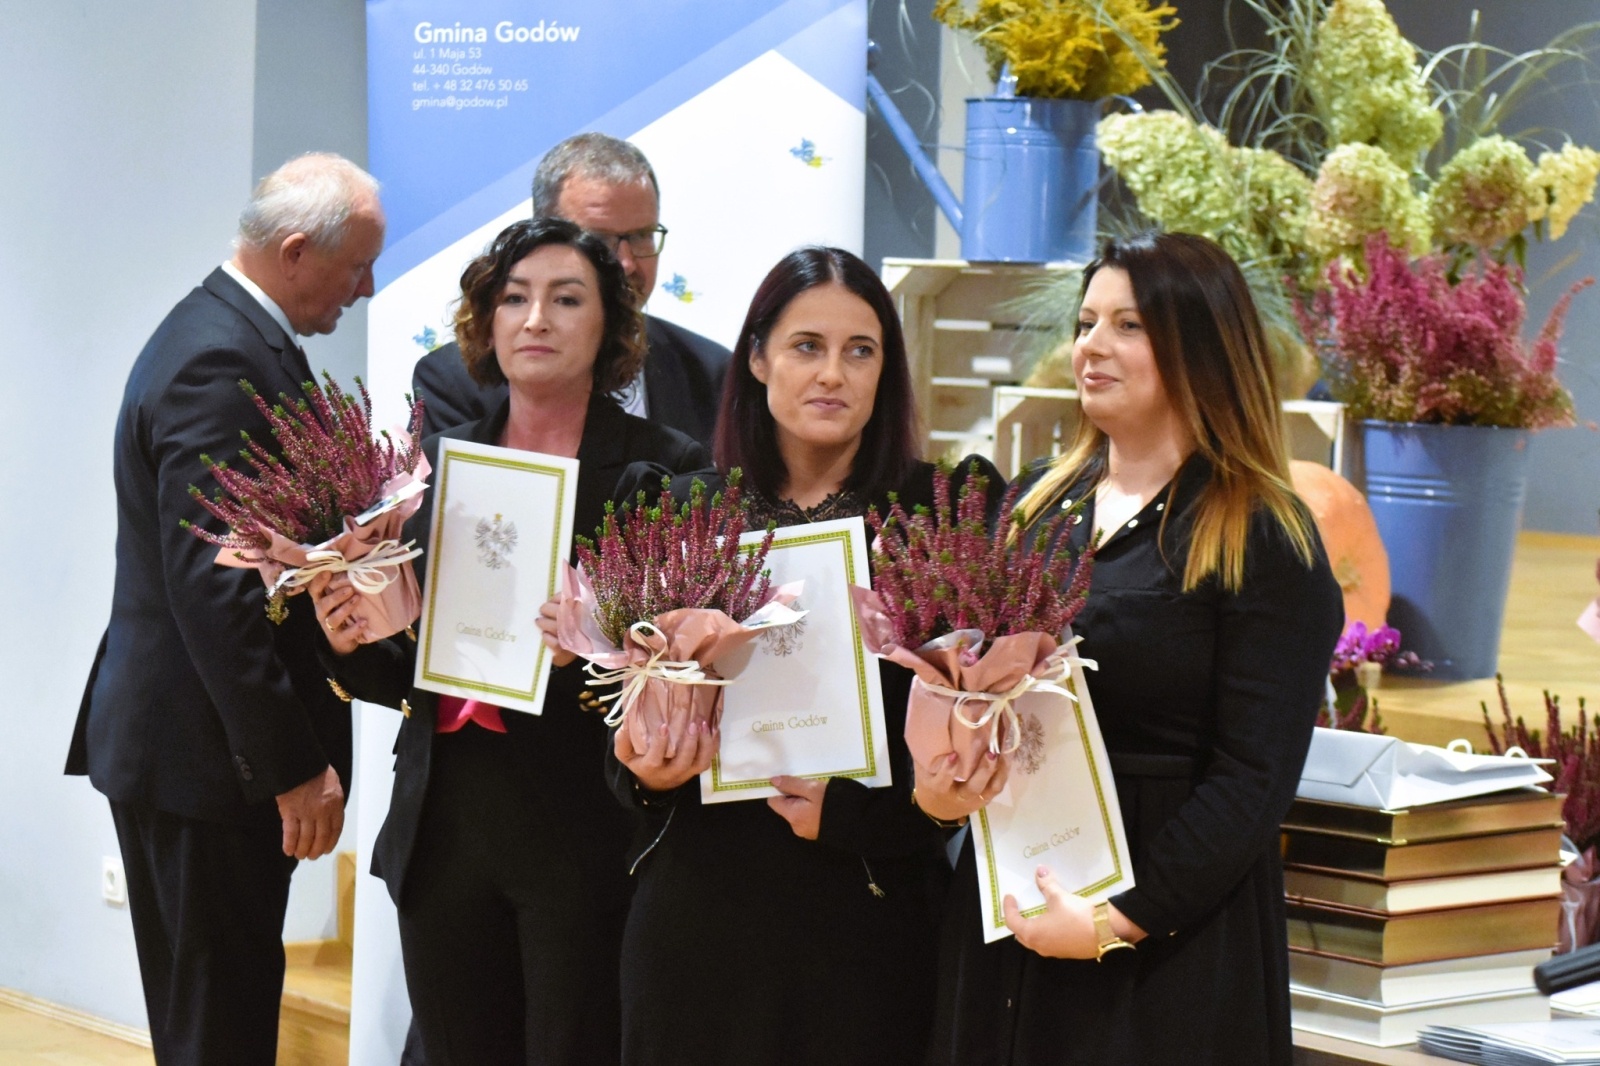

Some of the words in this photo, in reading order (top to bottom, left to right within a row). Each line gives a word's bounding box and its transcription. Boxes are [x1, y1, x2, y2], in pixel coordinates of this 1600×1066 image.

[414, 21, 488, 43] Gmina
[495, 19, 581, 43] Godów
[413, 48, 426, 60] ul.
[430, 48, 435, 59] 1
[438, 48, 466, 62] Maja
[468, 47, 482, 59] 53
[412, 64, 450, 76] 44-340
[452, 63, 493, 75] Godów
[412, 80, 430, 92] tel.
[443, 80, 457, 92] 48
[459, 80, 473, 91] 32
[474, 79, 496, 91] 476
[498, 79, 512, 91] 50
[514, 79, 529, 91] 65
[412, 95, 509, 110] gmina@godow.pl
[751, 719, 785, 733] Gmina
[787, 714, 828, 729] Godów
